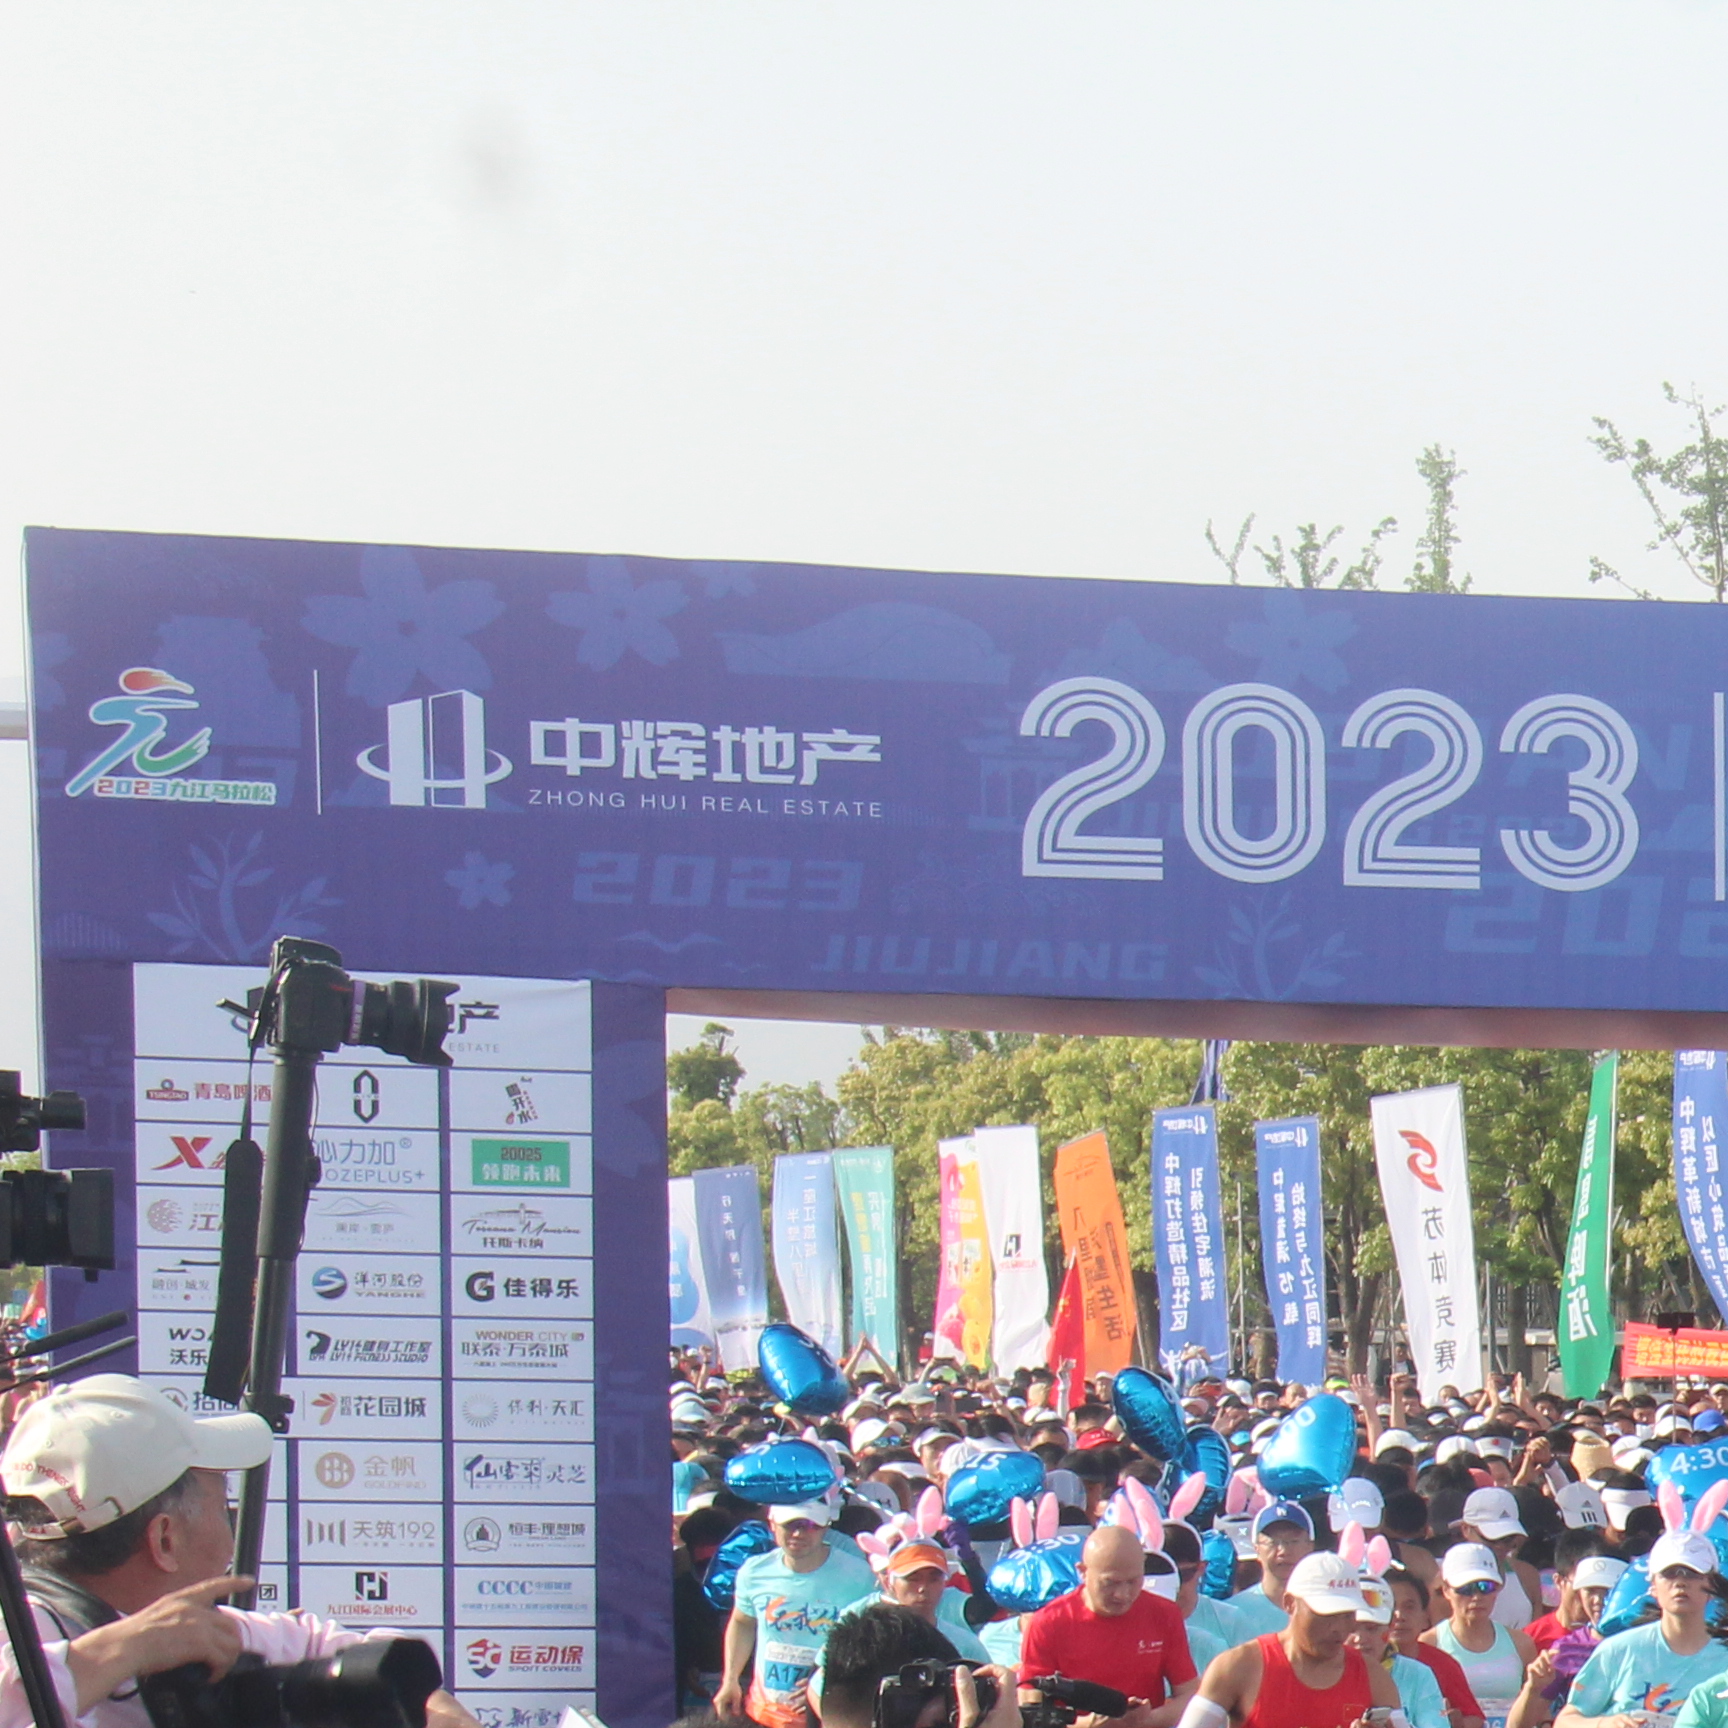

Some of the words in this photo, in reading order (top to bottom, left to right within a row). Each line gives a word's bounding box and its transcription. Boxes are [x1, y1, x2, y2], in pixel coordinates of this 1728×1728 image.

[529, 717, 883, 785] 中辉地产
[1020, 676, 1639, 893] 2023
[529, 789, 625, 809] ZHONG
[641, 793, 687, 811] HUI
[701, 796, 770, 815] REAL
[783, 800, 883, 818] ESTATE
[324, 1169, 426, 1184] OZEPLUS+
[353, 1271, 425, 1288] 洋河股份
[503, 1277, 580, 1299] 佳得乐
[475, 1330, 535, 1342] WONDER
[538, 1331, 569, 1342] CITY
[353, 1395, 427, 1418] 花园城
[363, 1455, 417, 1478] 金帆
[352, 1520, 436, 1540] 天筑192
[477, 1580, 534, 1596] CCCC
[326, 1604, 418, 1617] 九江国际会展中心
[508, 1645, 585, 1666] 运动保
